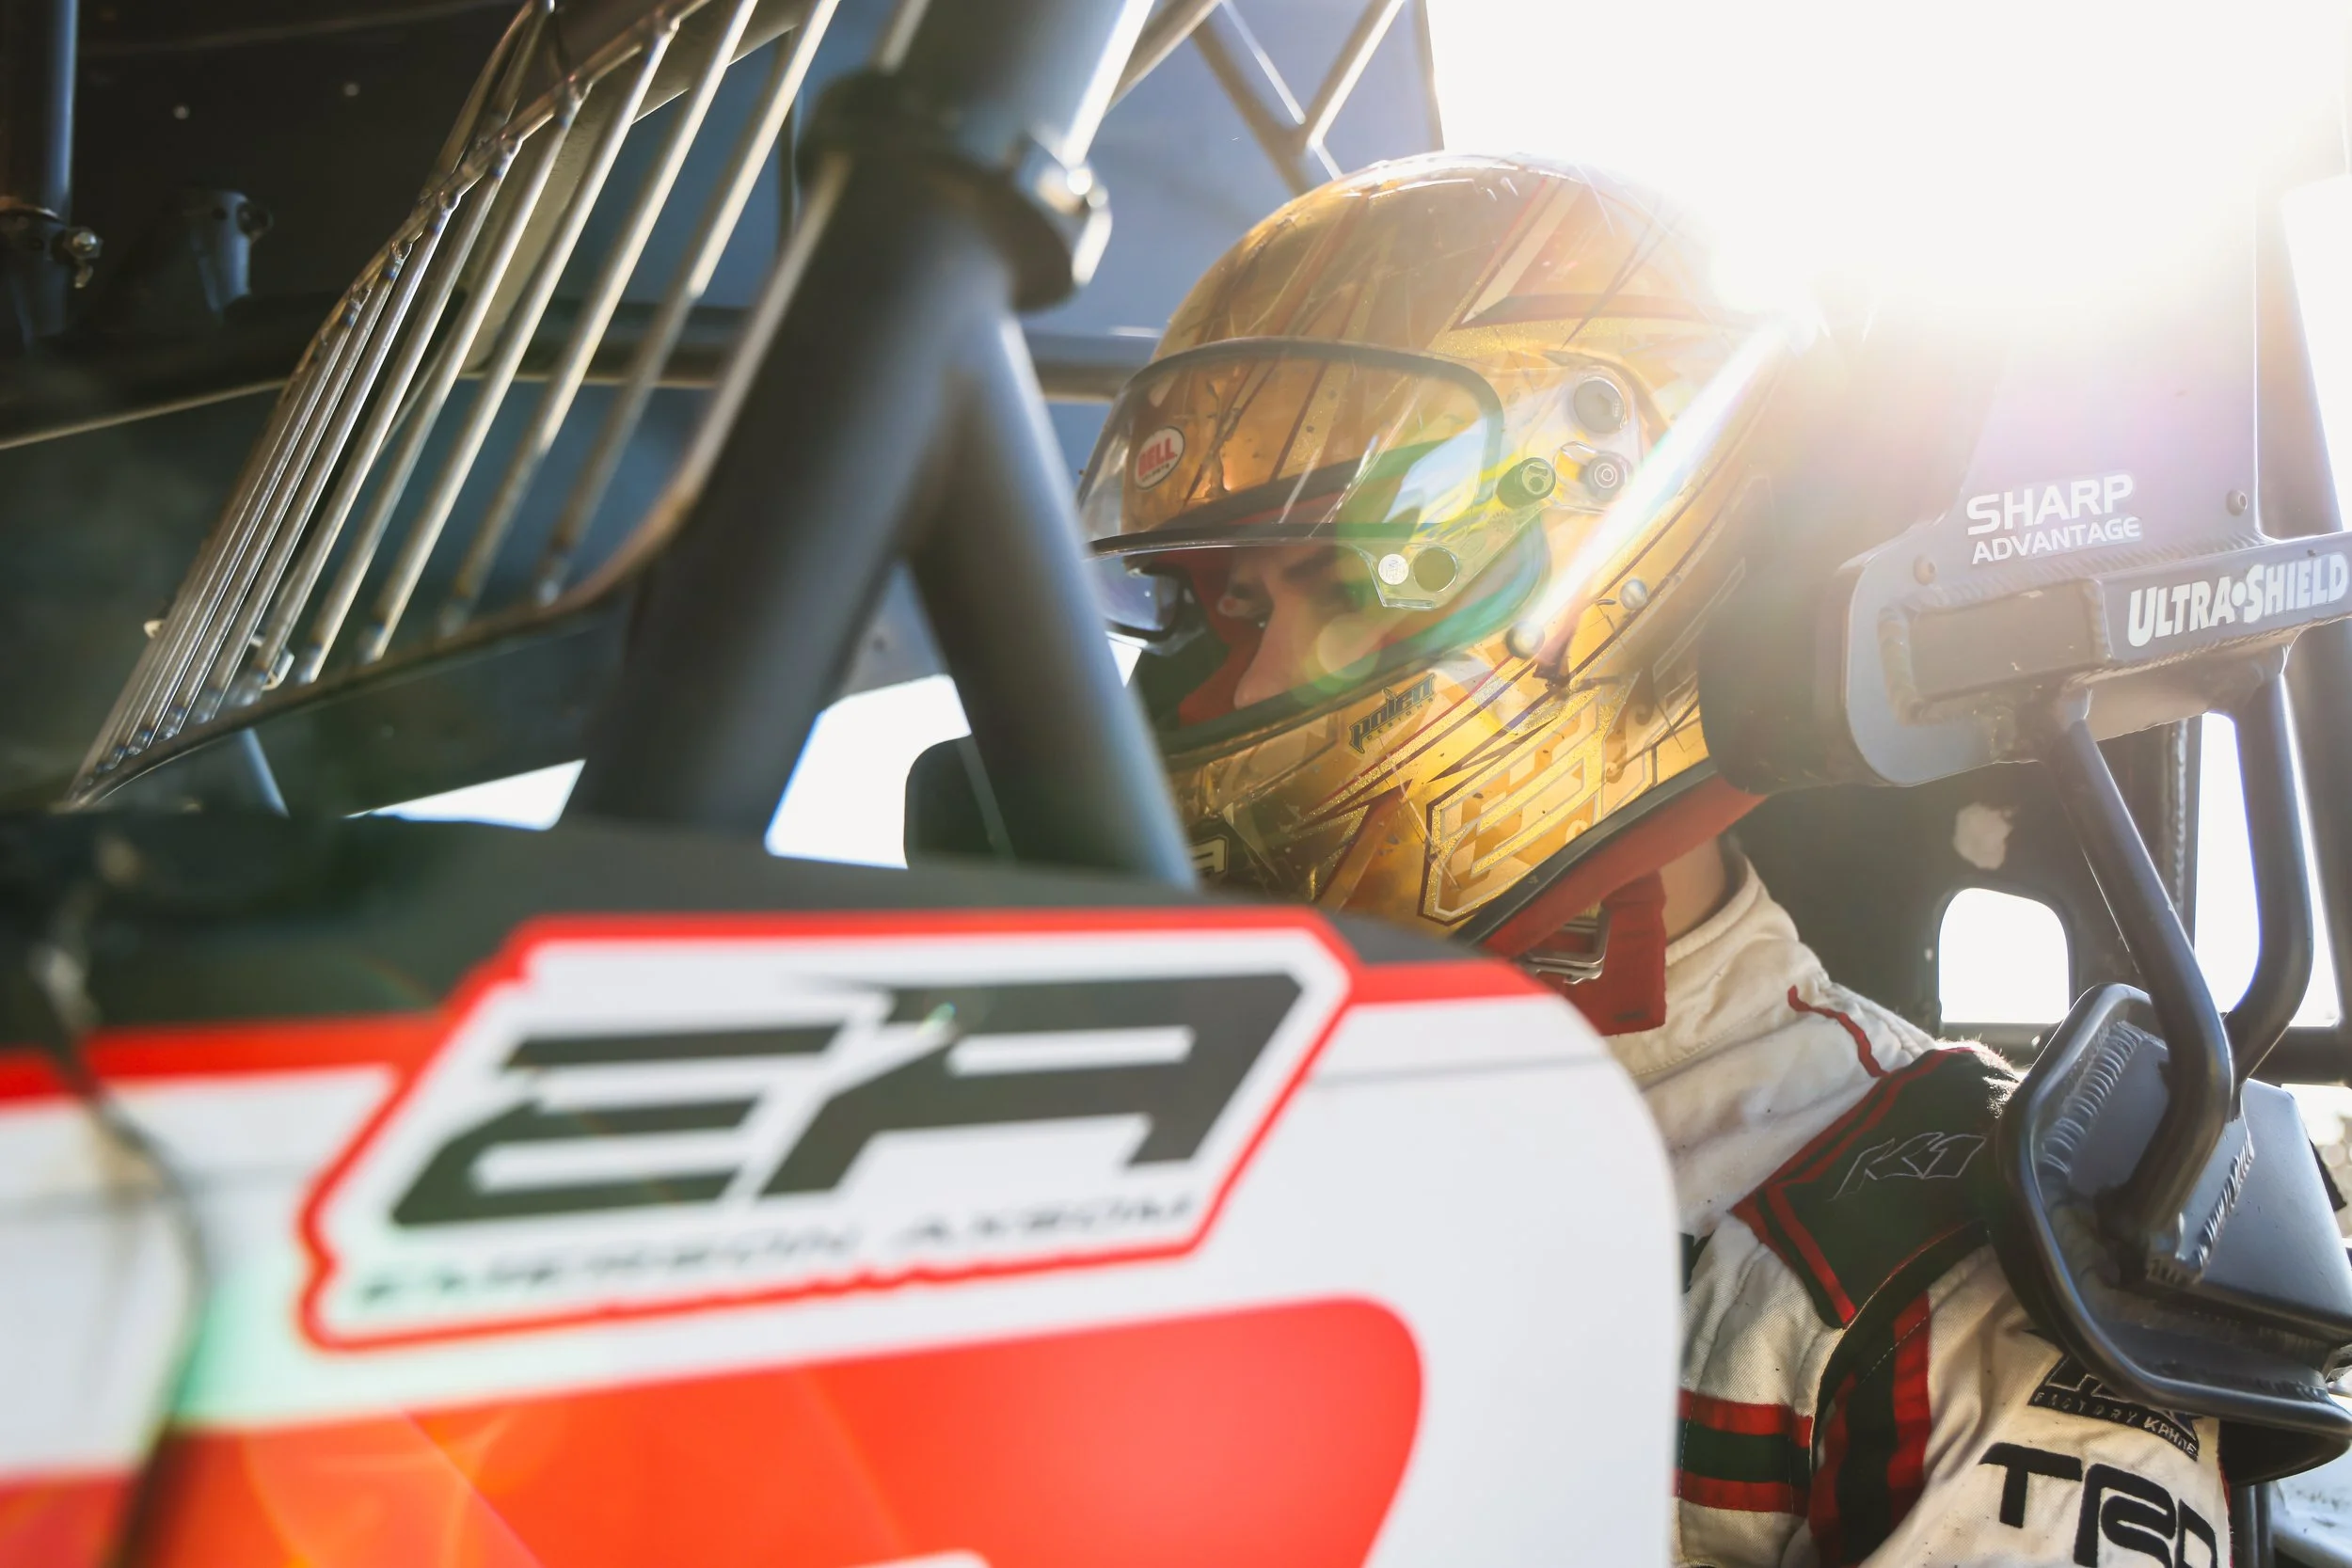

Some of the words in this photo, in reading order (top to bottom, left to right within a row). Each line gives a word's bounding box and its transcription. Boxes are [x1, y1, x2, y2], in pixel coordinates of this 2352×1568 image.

[1966, 474, 2134, 535] SHARP
[1972, 516, 2141, 564] ADVANTAGE
[389, 971, 1305, 1228] EA
[2034, 1392, 2137, 1423] FACTORY
